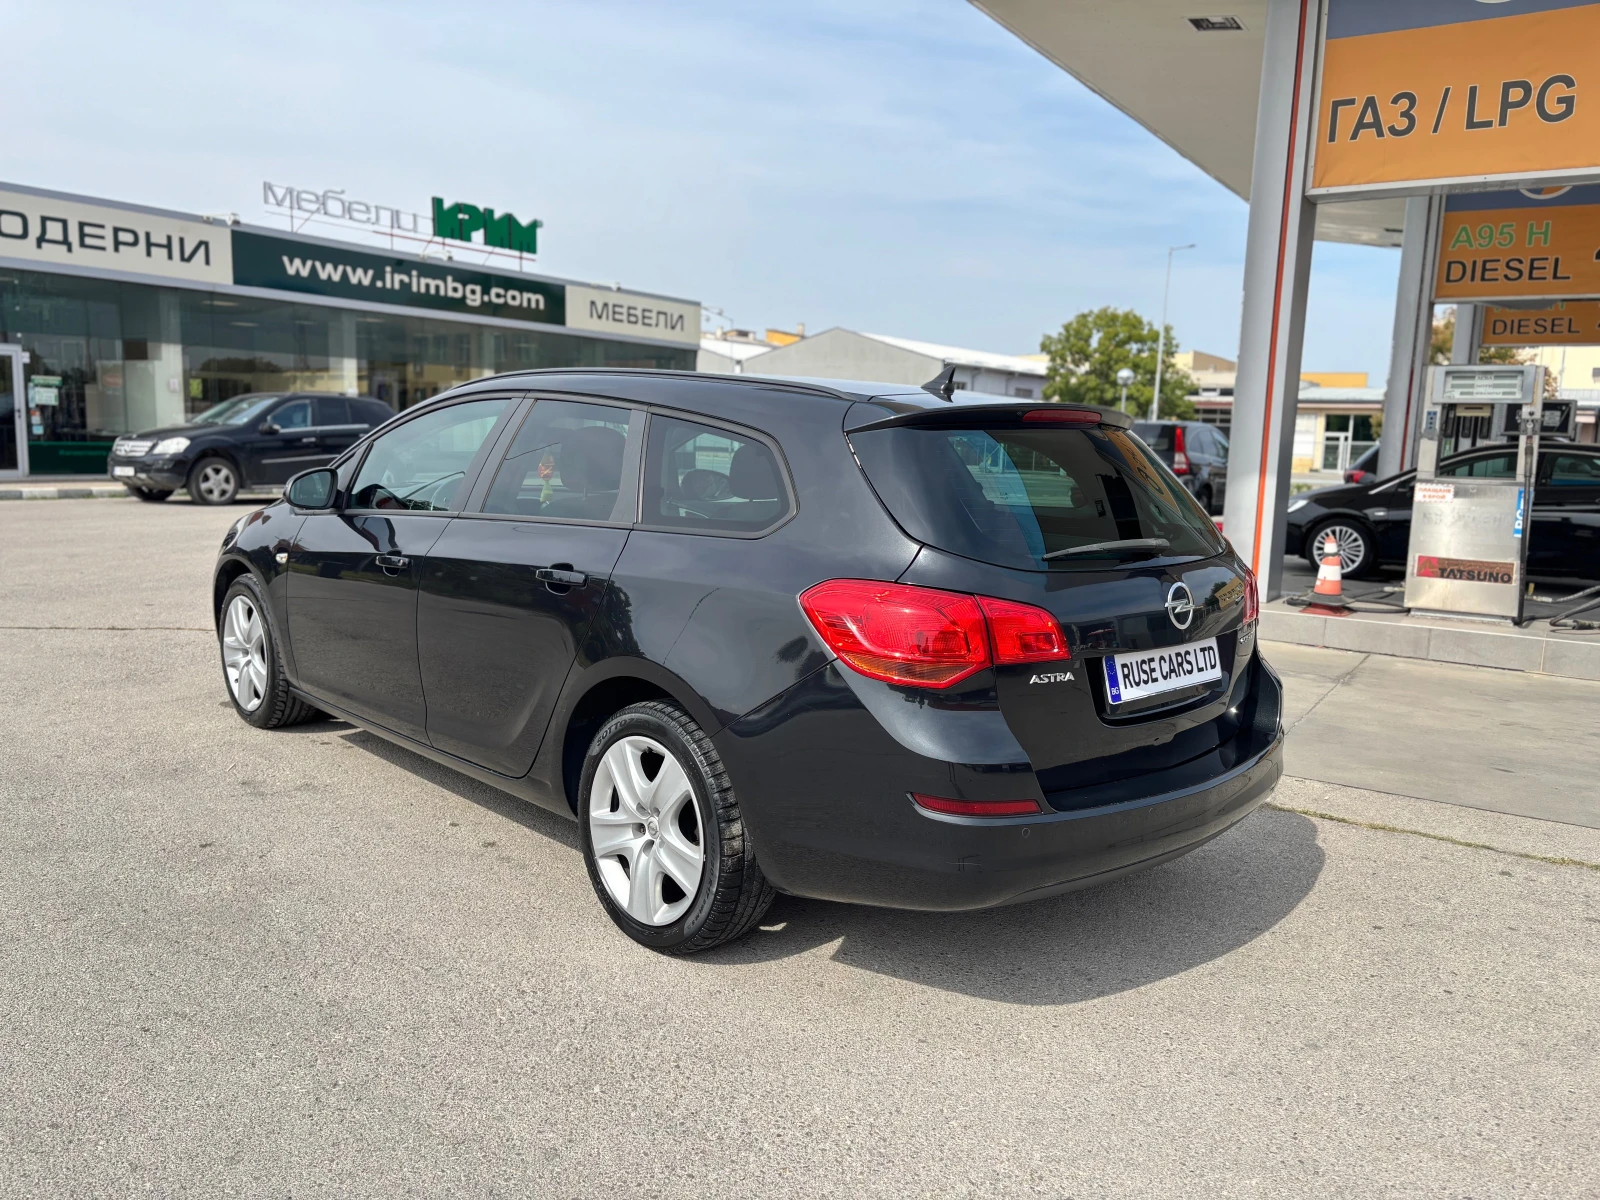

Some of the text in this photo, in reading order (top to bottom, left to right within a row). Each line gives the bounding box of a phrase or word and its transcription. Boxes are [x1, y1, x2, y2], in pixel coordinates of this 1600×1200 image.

[1327, 74, 1577, 143] ГАЗ / LPG
[282, 255, 545, 310] www.irimbg.com
[1445, 256, 1571, 284] DIESEL
[589, 300, 685, 332] МЕБЕЛИ
[1491, 317, 1580, 336] DIESEL
[1439, 567, 1512, 583] TATSUNO
[1029, 671, 1075, 685] ASTRA
[1121, 645, 1217, 690] RUSE CARS LTD
[1111, 686, 1120, 696] BG
